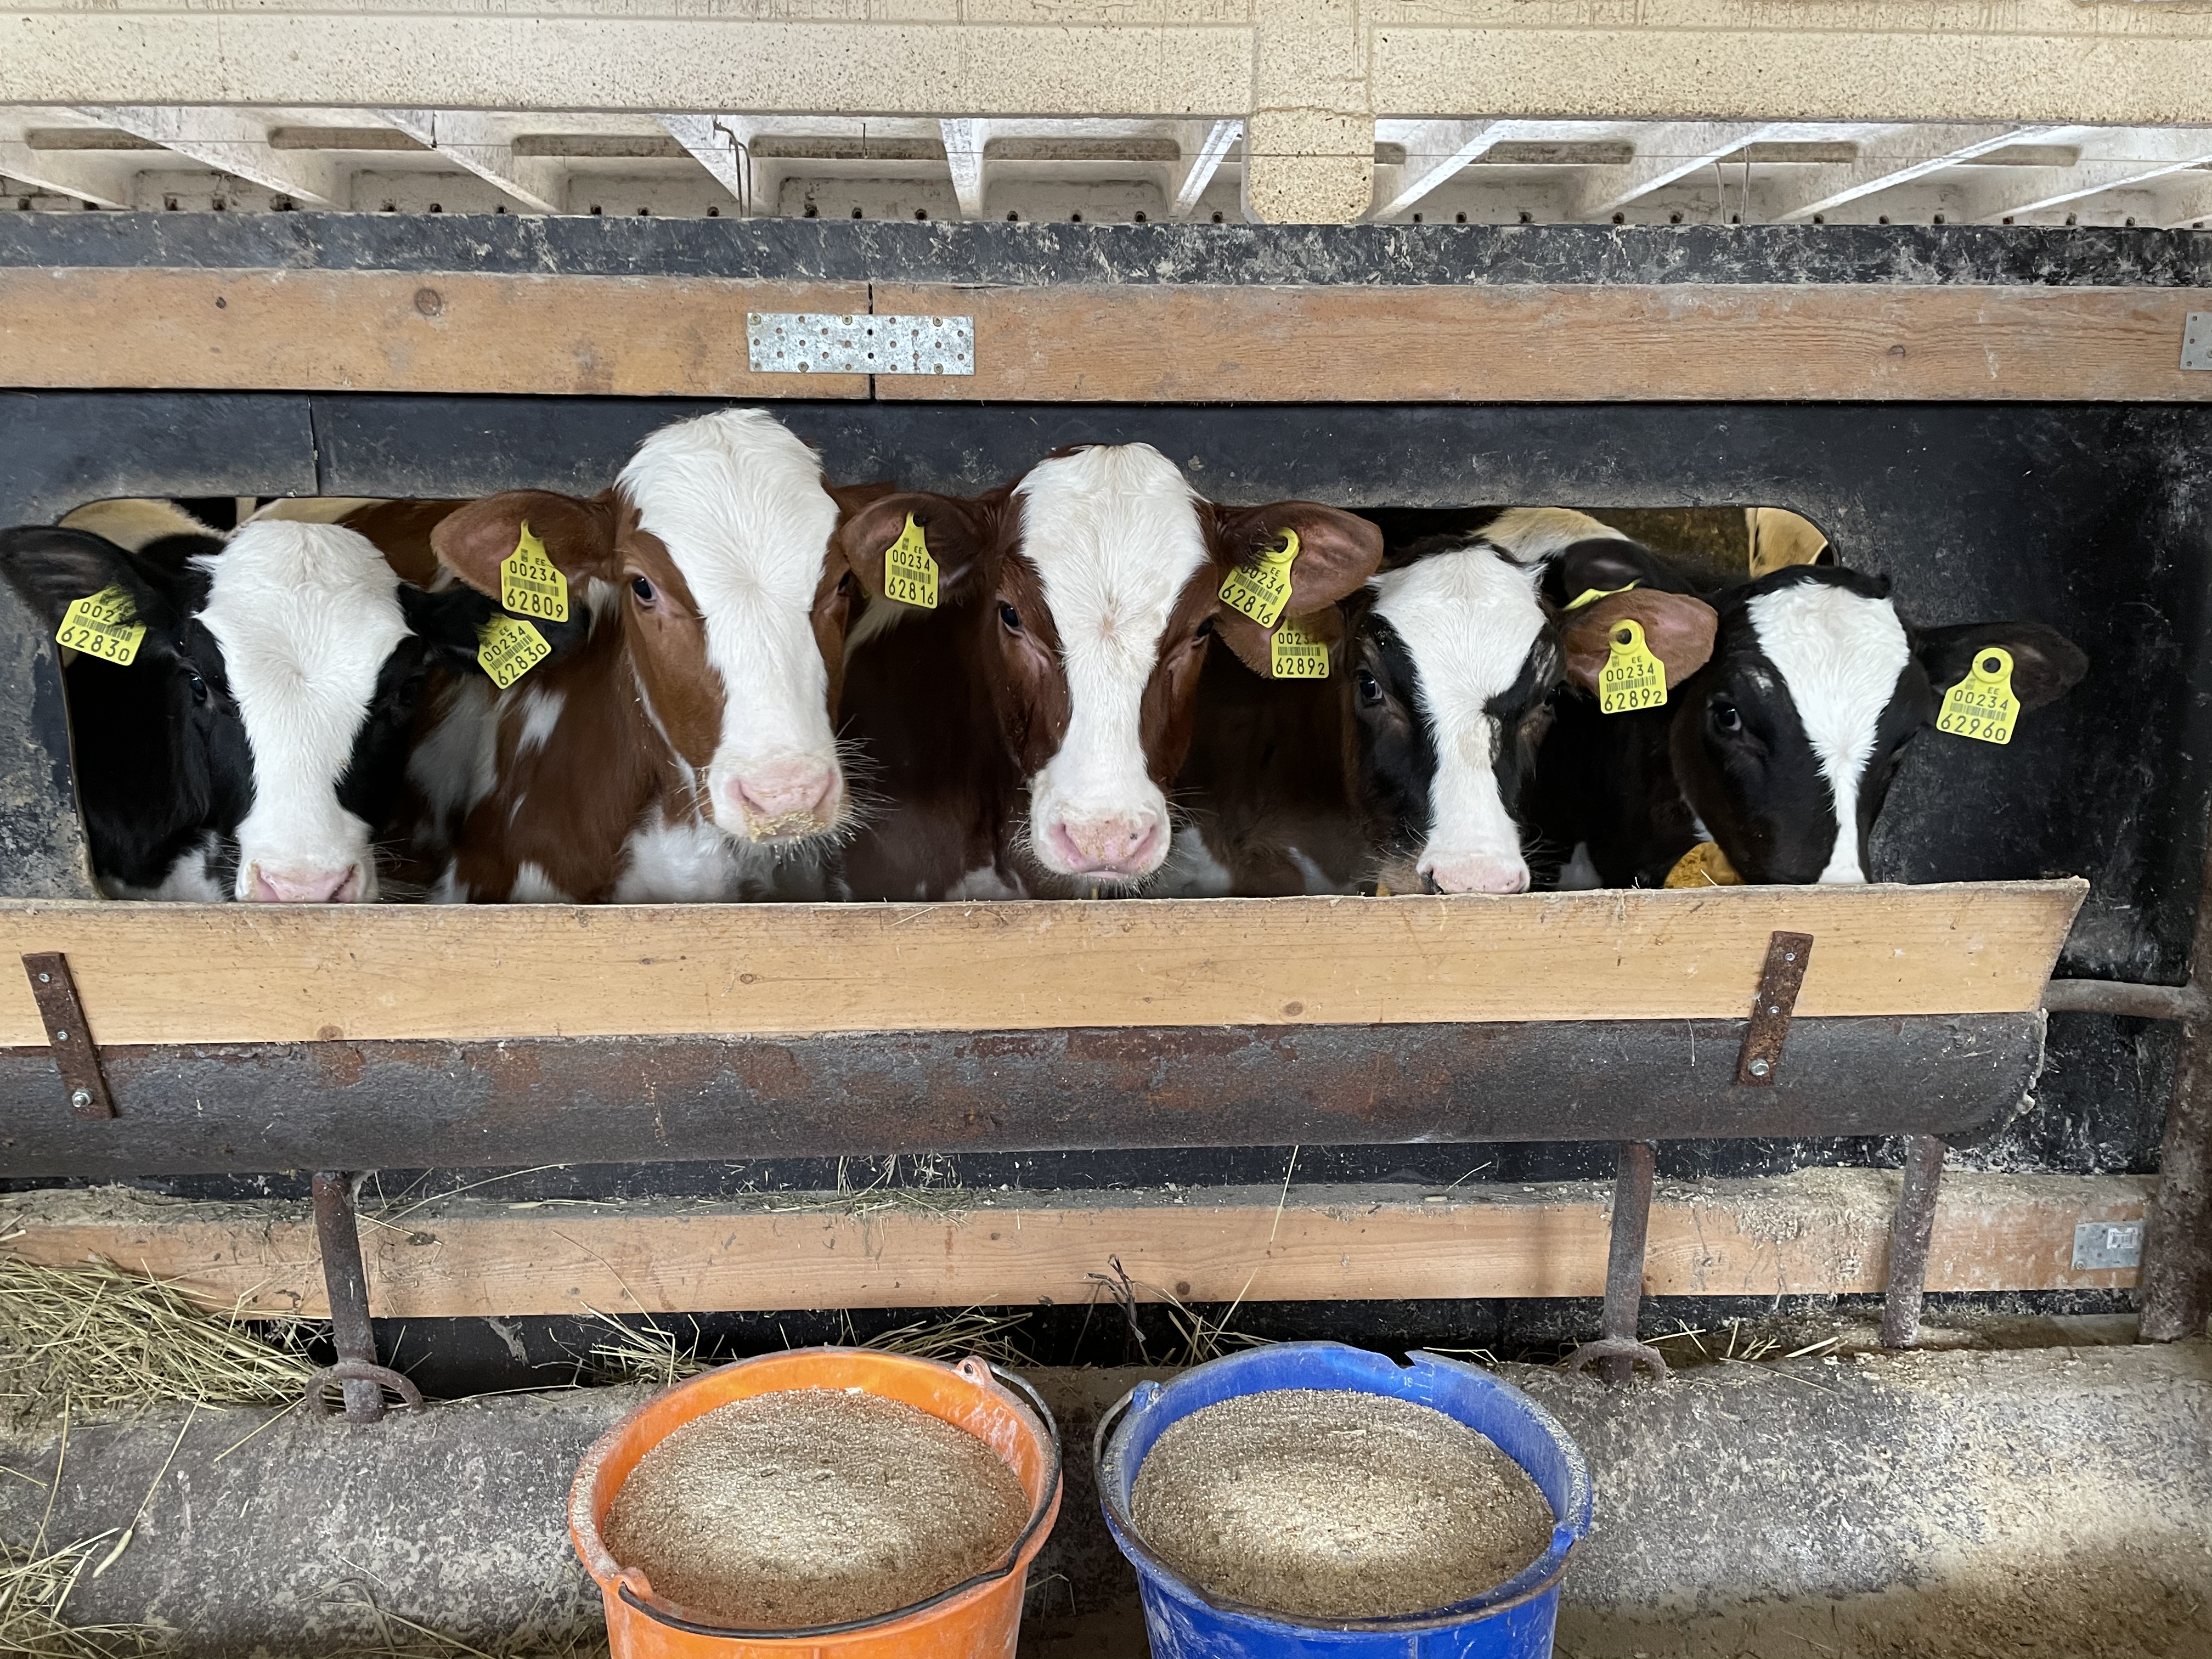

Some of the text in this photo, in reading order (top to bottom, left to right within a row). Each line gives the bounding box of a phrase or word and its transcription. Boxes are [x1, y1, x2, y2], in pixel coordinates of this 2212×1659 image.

[893, 550, 930, 572] 00234
[914, 546, 923, 554] EE
[510, 560, 557, 584] 00234
[535, 558, 546, 567] EE
[1270, 567, 1281, 577] EE
[889, 577, 934, 605] 62816
[507, 588, 564, 618] 62809
[1222, 584, 1273, 624] 62816
[499, 626, 510, 636] EE
[61, 626, 130, 662] 62830
[483, 625, 526, 662] 00234
[498, 643, 547, 686] 62830
[1276, 657, 1325, 675] 62892
[1632, 656, 1642, 664] EE
[1606, 663, 1654, 682] 00234
[1604, 688, 1662, 712] 62892
[1954, 690, 2008, 711] 00234
[1987, 687, 2000, 695] EE
[1940, 713, 2006, 741] 62960
